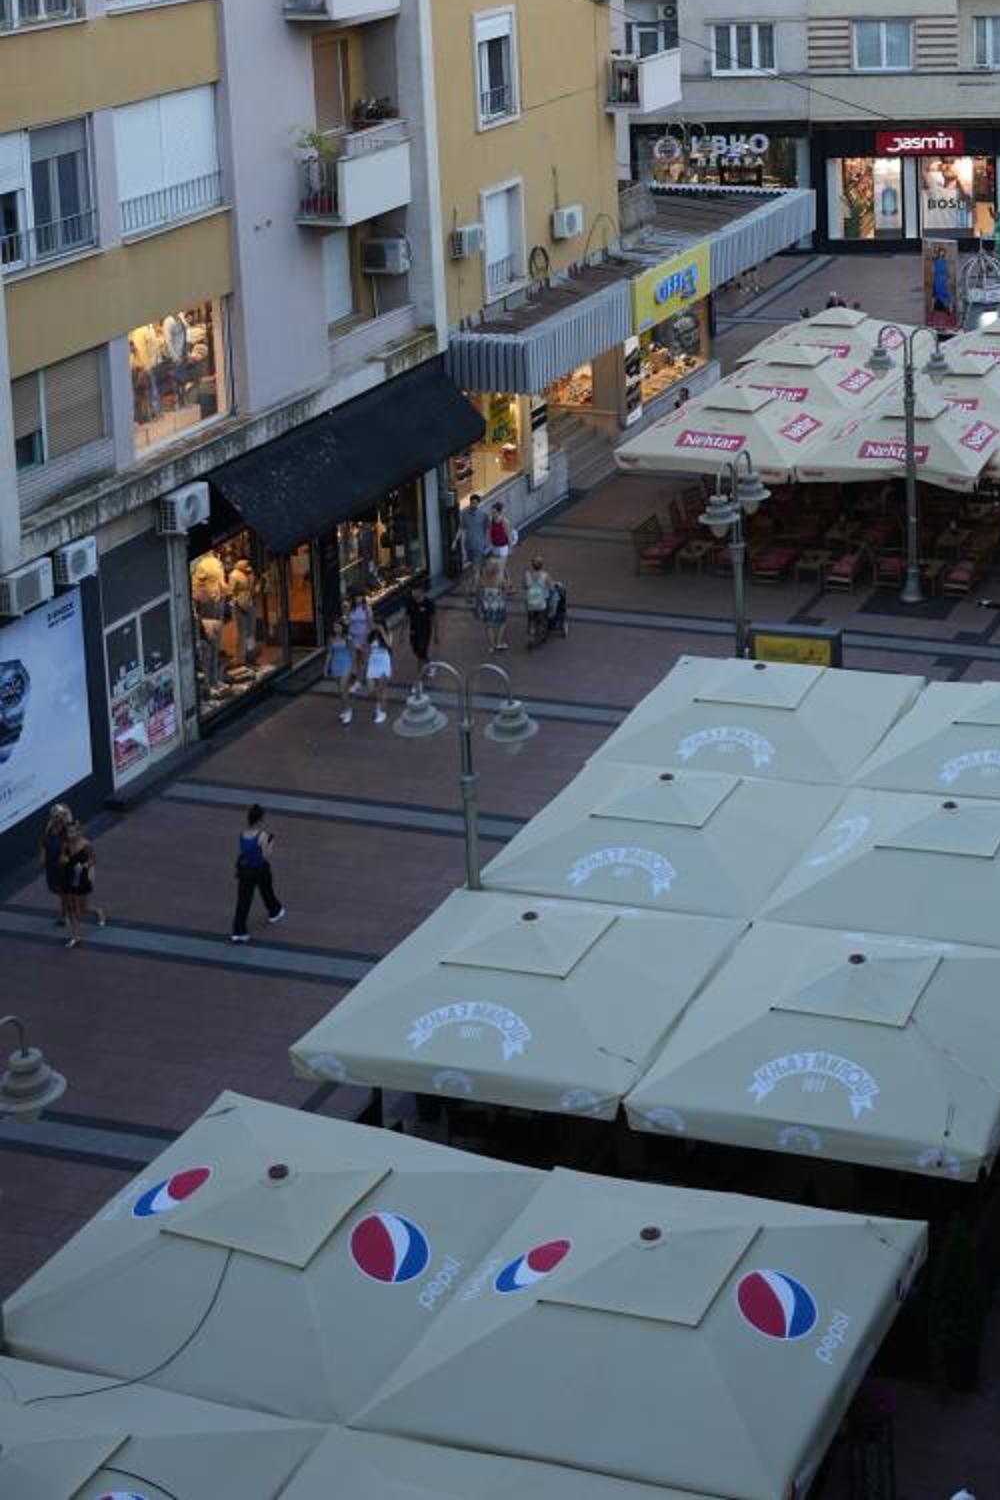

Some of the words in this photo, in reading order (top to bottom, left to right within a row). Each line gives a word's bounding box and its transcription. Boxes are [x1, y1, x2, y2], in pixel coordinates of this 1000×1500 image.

[683, 432, 742, 449] Nektar
[865, 445, 924, 463] Nektr
[753, 1054, 809, 1080] КЊАЗ
[813, 1054, 880, 1096] МИЛОШ
[418, 1255, 461, 1310] pepsi
[814, 1309, 850, 1365] pepsi
